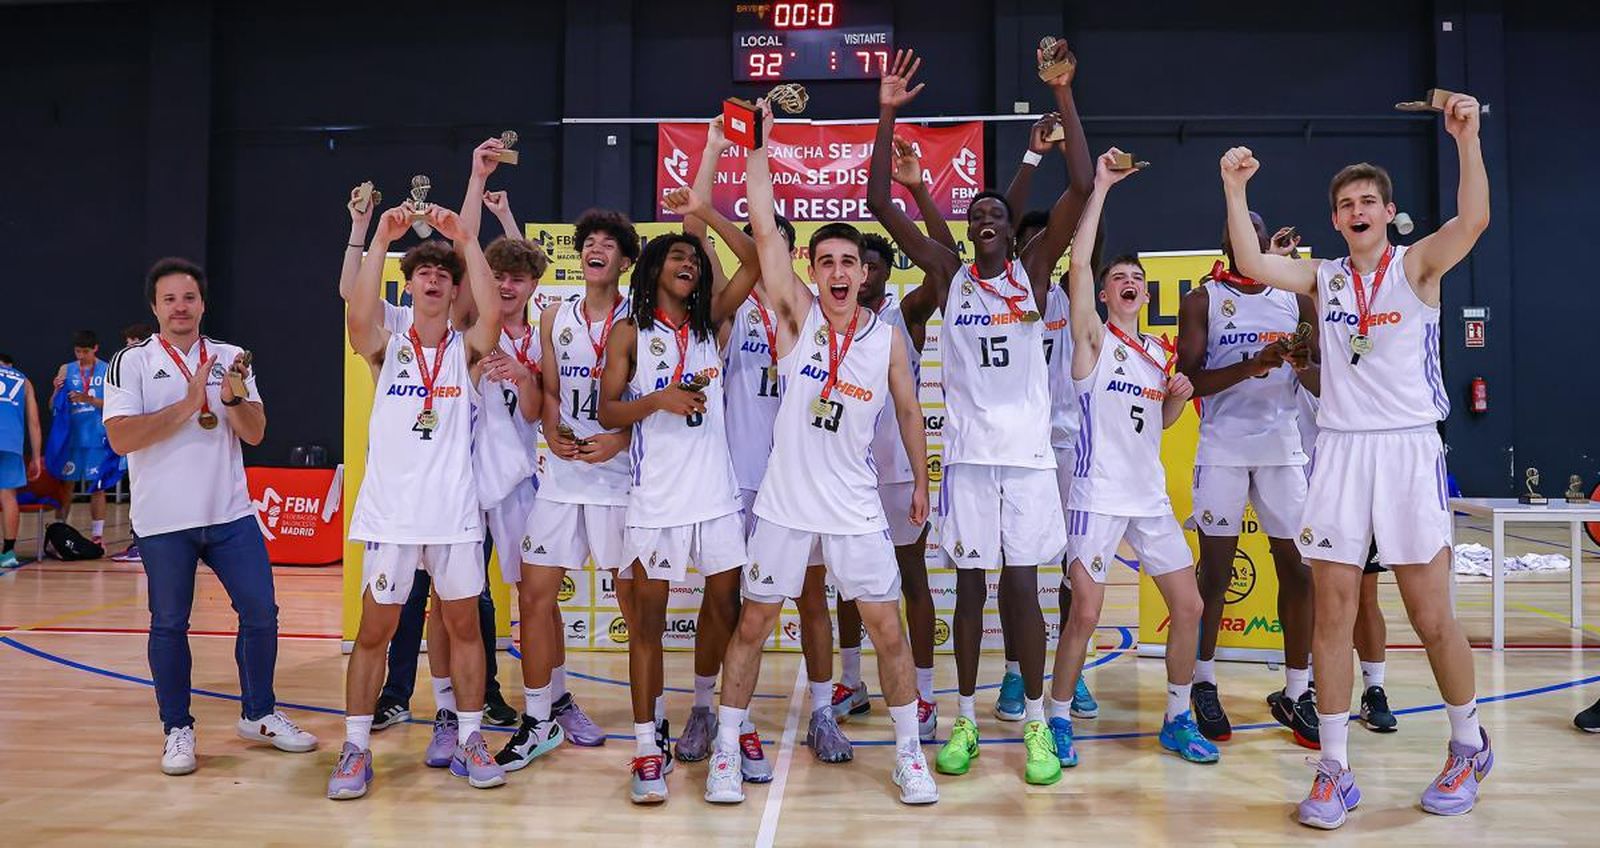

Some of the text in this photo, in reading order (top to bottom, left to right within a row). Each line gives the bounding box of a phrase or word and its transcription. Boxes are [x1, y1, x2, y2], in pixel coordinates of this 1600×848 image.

[774, 3, 834, 27] 00:0
[740, 36, 783, 47] LOCAL
[843, 33, 886, 45] VISITANTE
[749, 53, 783, 77] 92
[856, 51, 888, 73] 77
[828, 142, 853, 159] SE
[769, 173, 802, 185] ADA
[806, 168, 830, 185] SE
[734, 198, 906, 219] CN RESPEO
[978, 336, 1010, 368] 15
[800, 364, 874, 402] AUTHERO
[1129, 404, 1145, 434] 5
[284, 496, 320, 514] FBM
[280, 526, 315, 537] MADRID
